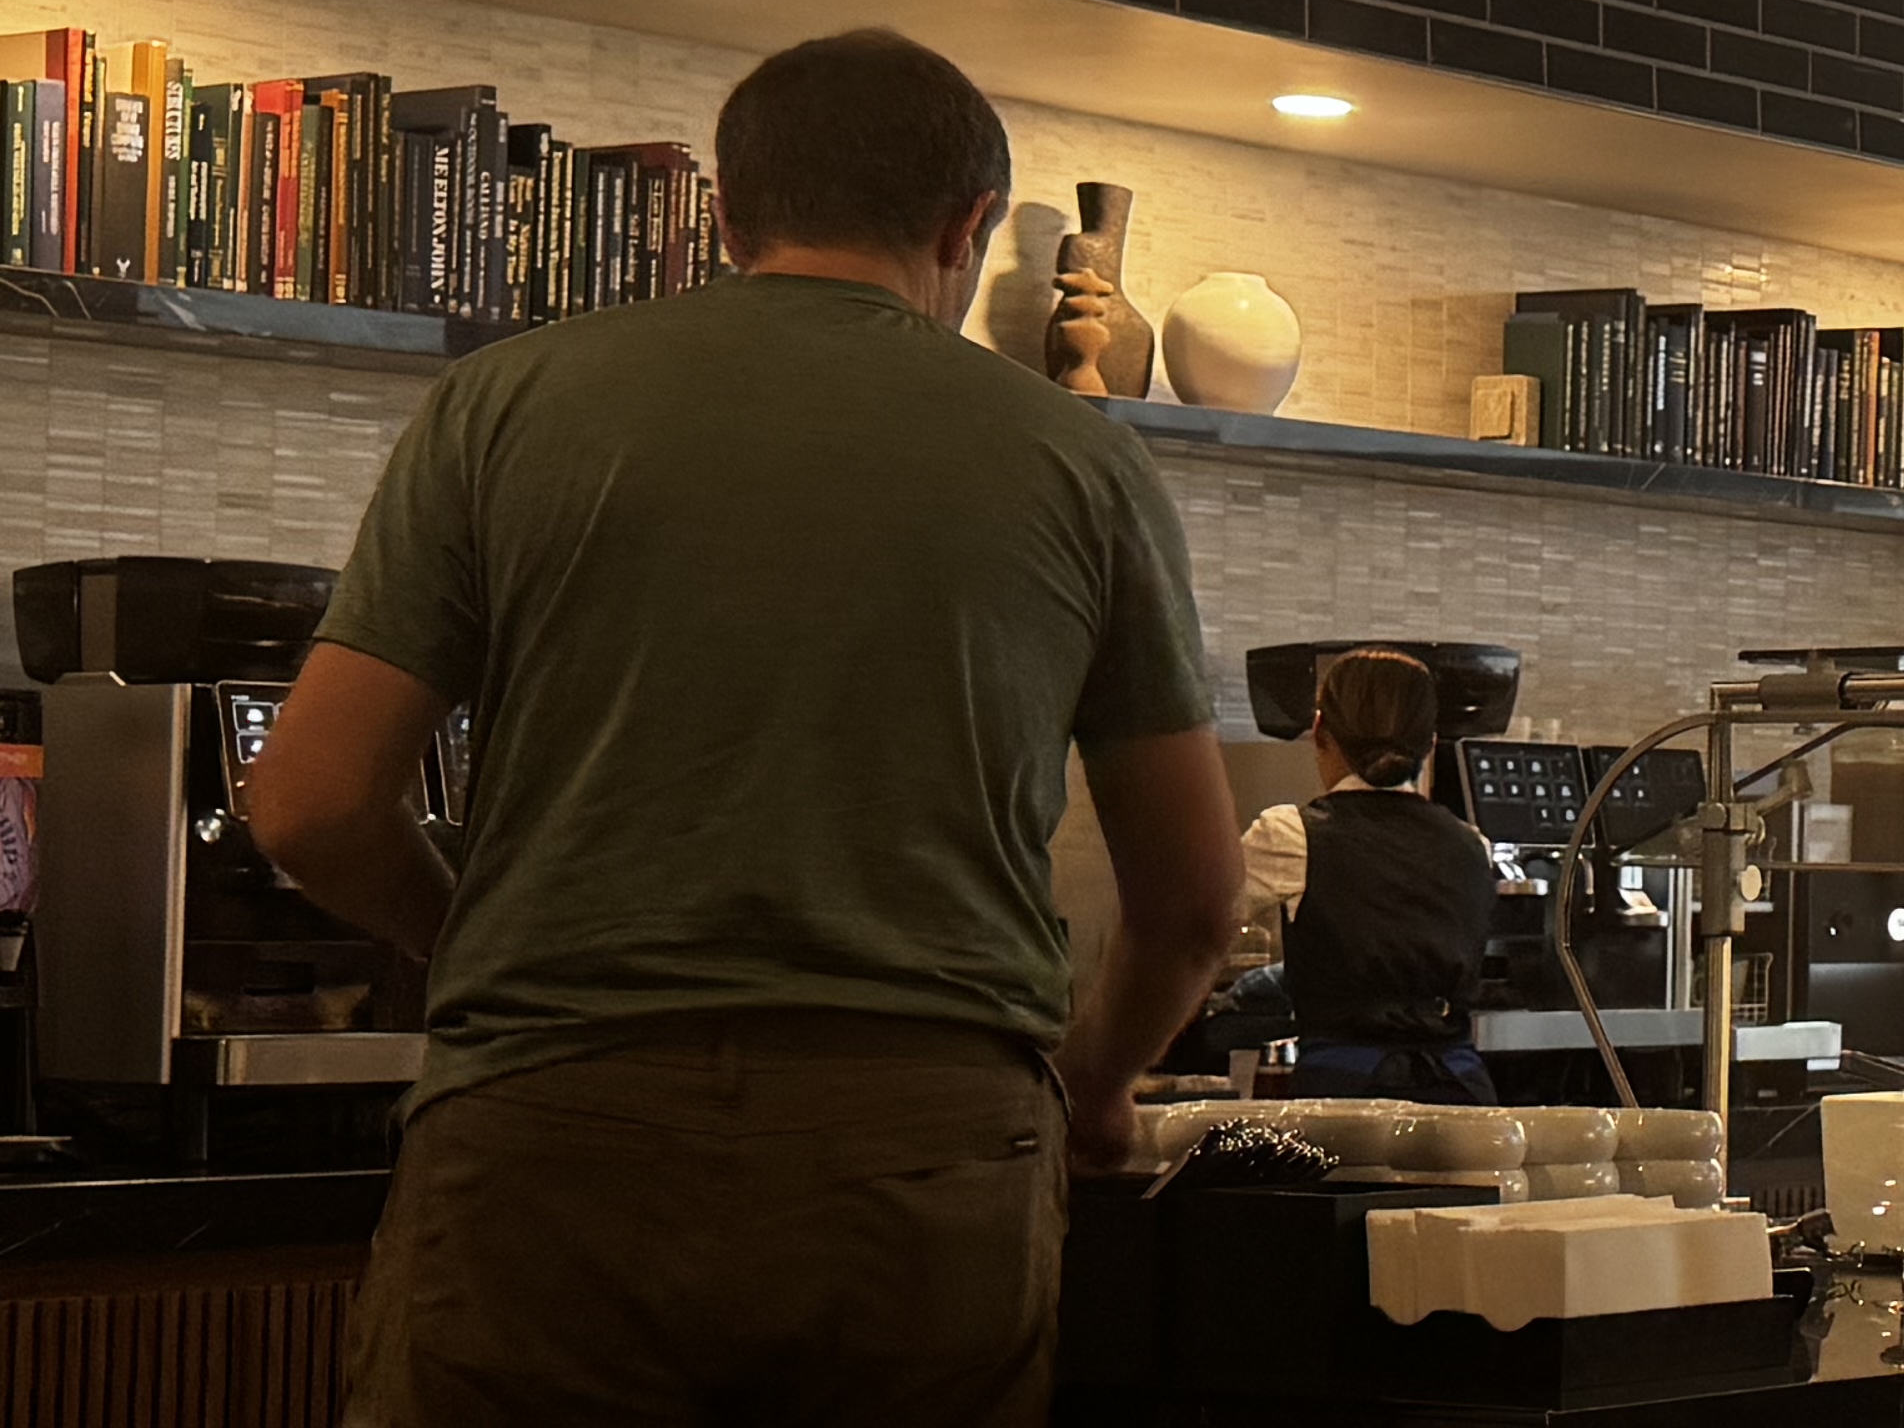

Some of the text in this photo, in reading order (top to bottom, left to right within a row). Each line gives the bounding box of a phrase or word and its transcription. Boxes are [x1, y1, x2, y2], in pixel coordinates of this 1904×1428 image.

[430, 145, 449, 290] ME ELTON JOHN
